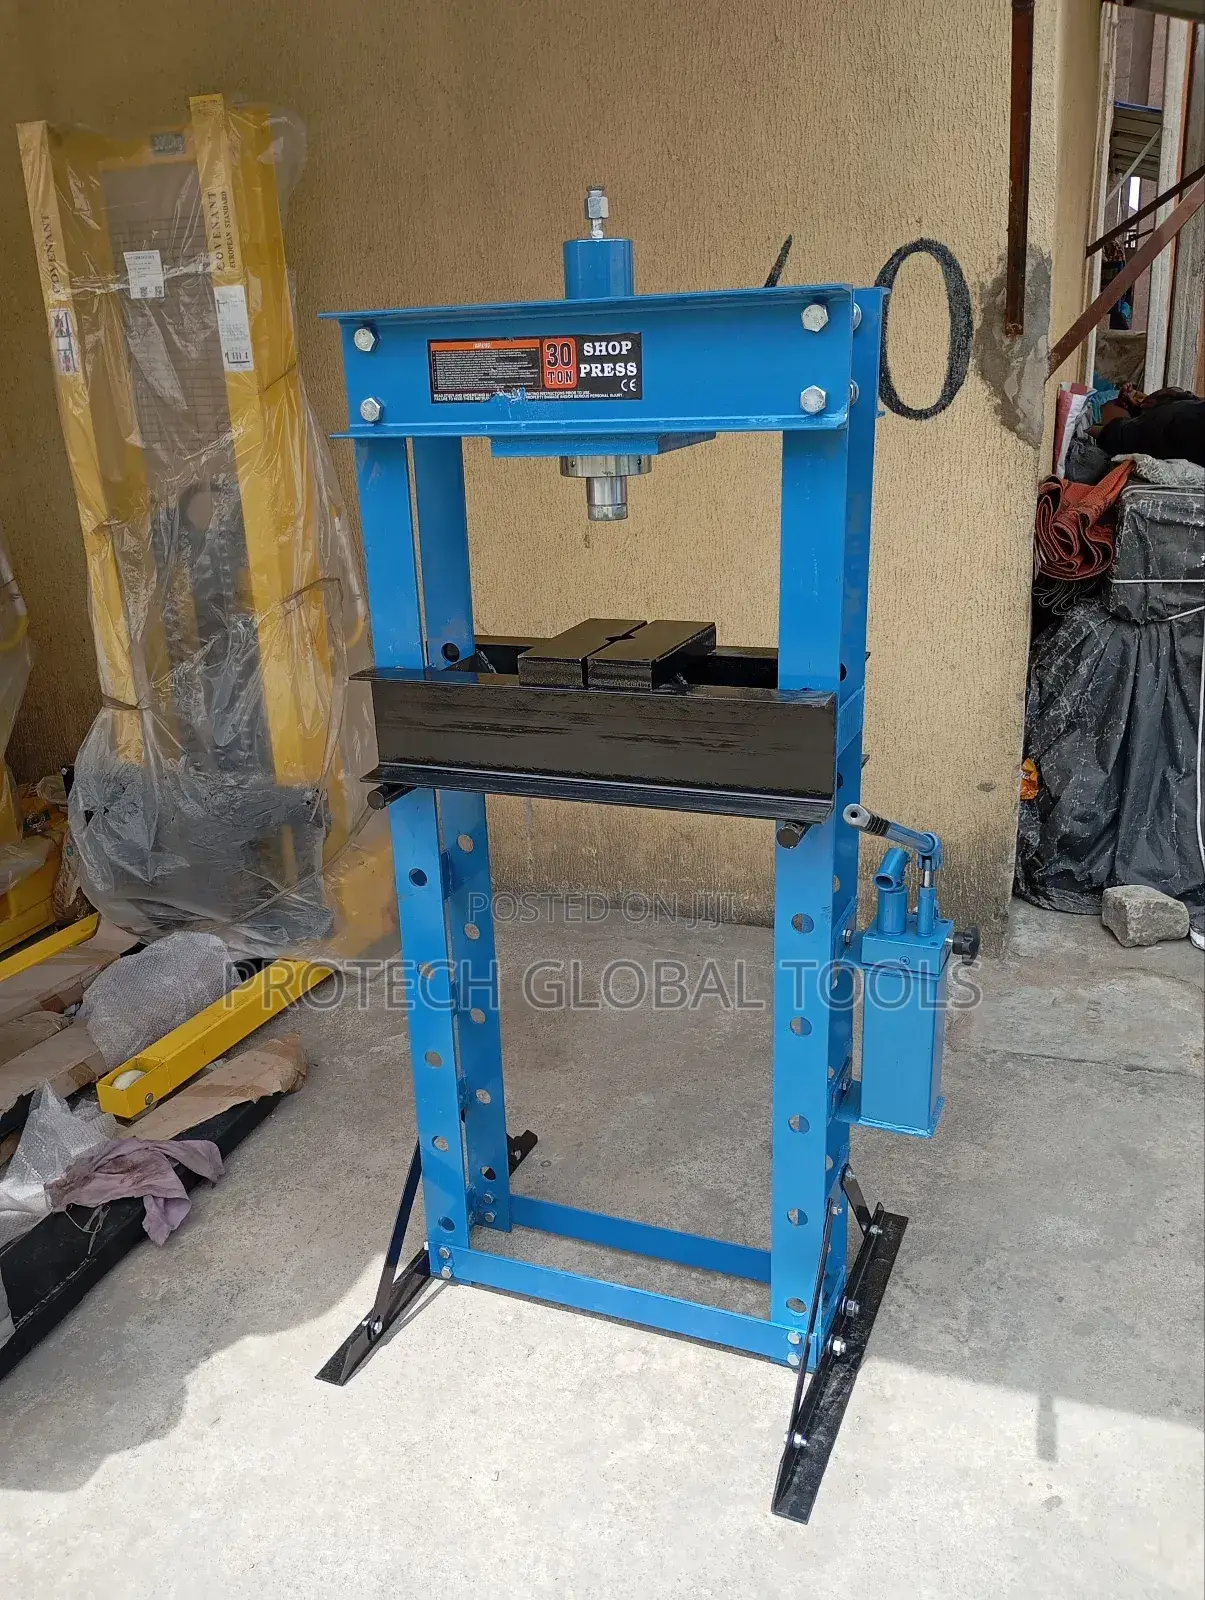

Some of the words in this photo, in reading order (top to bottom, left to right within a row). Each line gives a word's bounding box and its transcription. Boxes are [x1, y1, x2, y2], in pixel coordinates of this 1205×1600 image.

[221, 191, 231, 229] STANDARD
[208, 191, 226, 271] COVENANT
[226, 231, 236, 268] EUROPEAN
[545, 342, 573, 369] 30
[583, 340, 632, 356] SHOP
[547, 369, 574, 385] TON
[579, 362, 638, 378] PRESS
